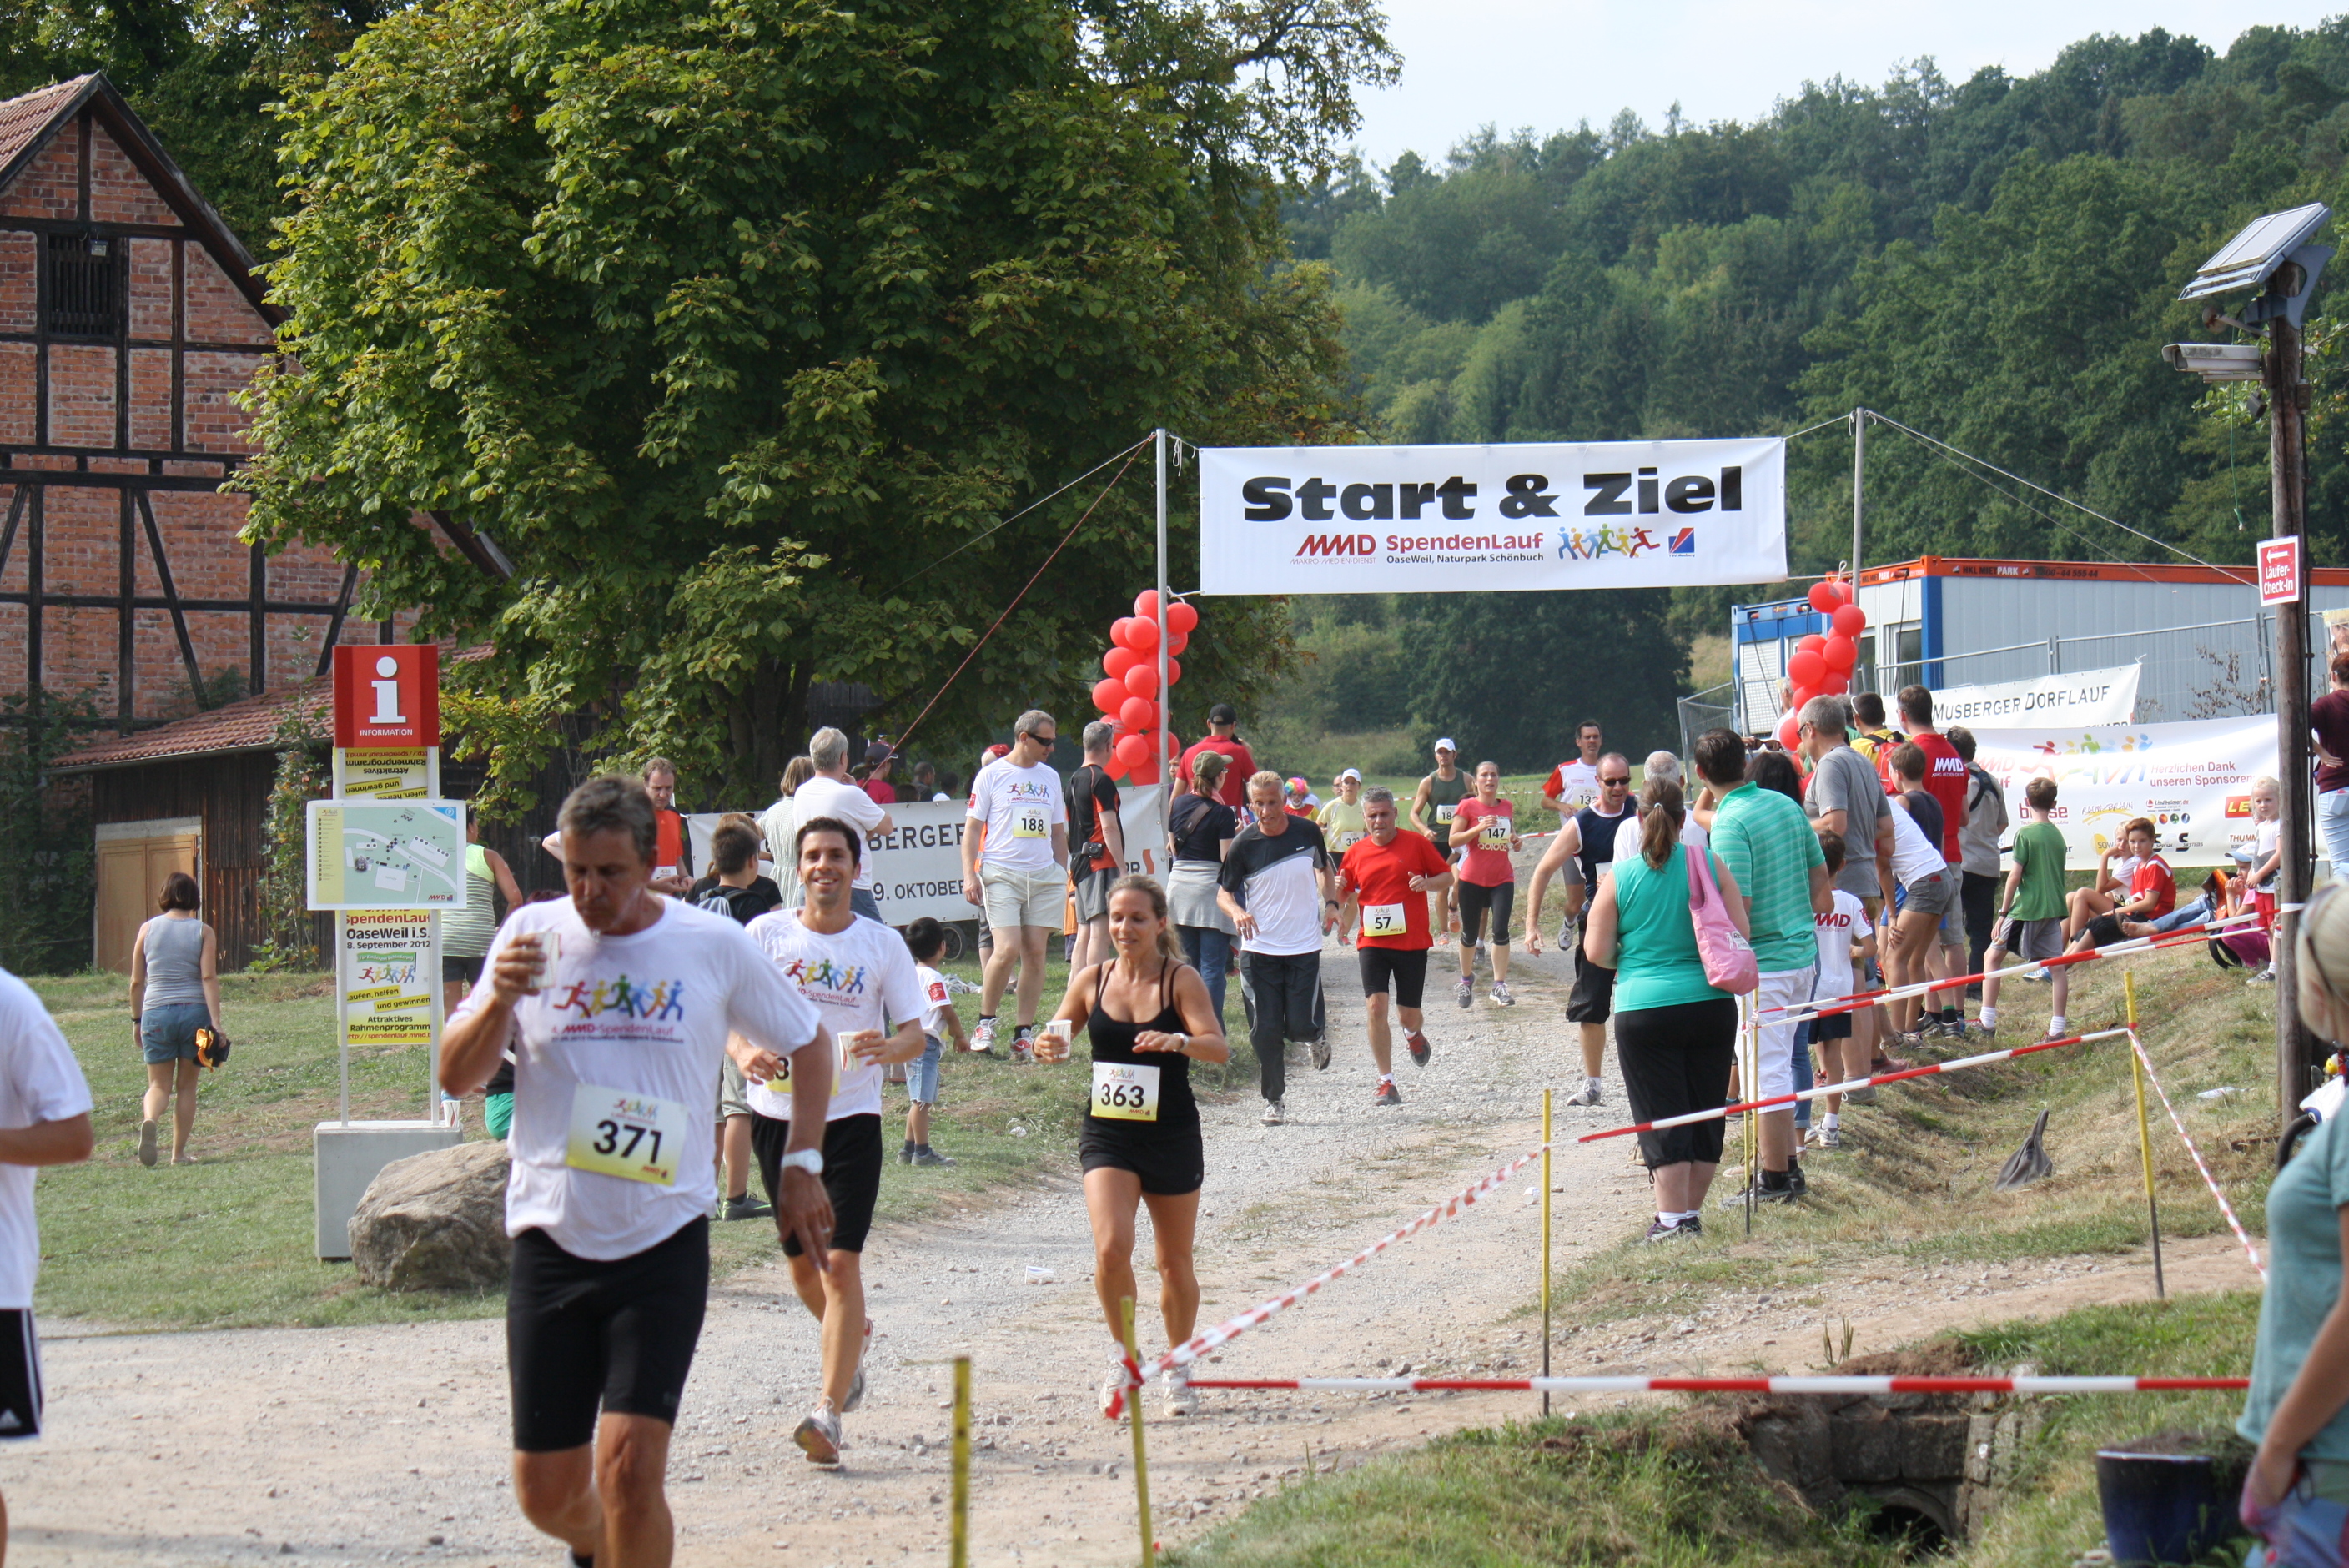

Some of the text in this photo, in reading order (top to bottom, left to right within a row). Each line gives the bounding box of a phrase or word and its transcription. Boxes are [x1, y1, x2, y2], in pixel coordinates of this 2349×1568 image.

[1242, 465, 1742, 521] Start & Ziel
[1295, 535, 1376, 556] MMD
[1386, 532, 1544, 554] SpendenLauf
[1386, 553, 1544, 565] OaseWeil, Naturpark Schönbuch
[1979, 566, 2019, 575] MIETPARK
[2265, 565, 2291, 580] Läufer-
[1932, 685, 2110, 722] MUSBERGER DORFLAUF
[1934, 757, 1964, 772] MMD
[2150, 761, 2236, 774] Herzlichen Dank
[2150, 776, 2192, 787] unseren
[1021, 817, 1044, 832] 188
[1487, 827, 1506, 839] 147
[1375, 916, 1392, 930] 57
[346, 927, 430, 940] OaseWeil i.S.
[357, 942, 408, 950] September
[410, 940, 430, 948] 2012
[374, 988, 400, 997] helfen
[393, 996, 431, 1008] gewinnen
[350, 1023, 430, 1032] Rahmenprogramm
[1101, 1083, 1144, 1108] 363
[593, 1119, 663, 1164] 371
